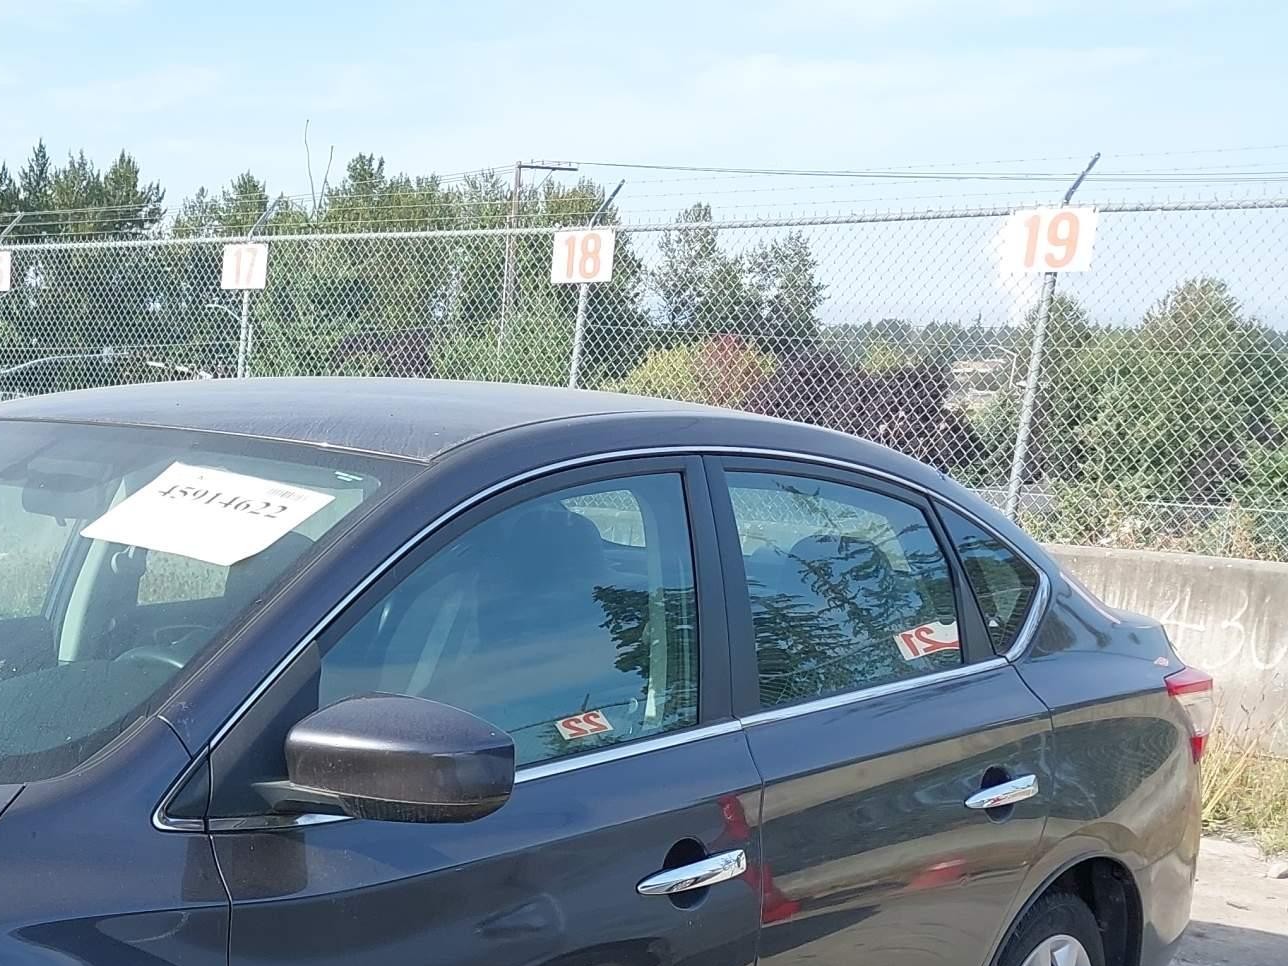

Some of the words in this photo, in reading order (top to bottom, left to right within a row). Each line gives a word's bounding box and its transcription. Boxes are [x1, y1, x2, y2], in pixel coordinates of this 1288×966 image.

[564, 233, 602, 280] 18
[1023, 211, 1080, 268] 19
[233, 247, 258, 286] 17
[158, 484, 288, 518] 45914622
